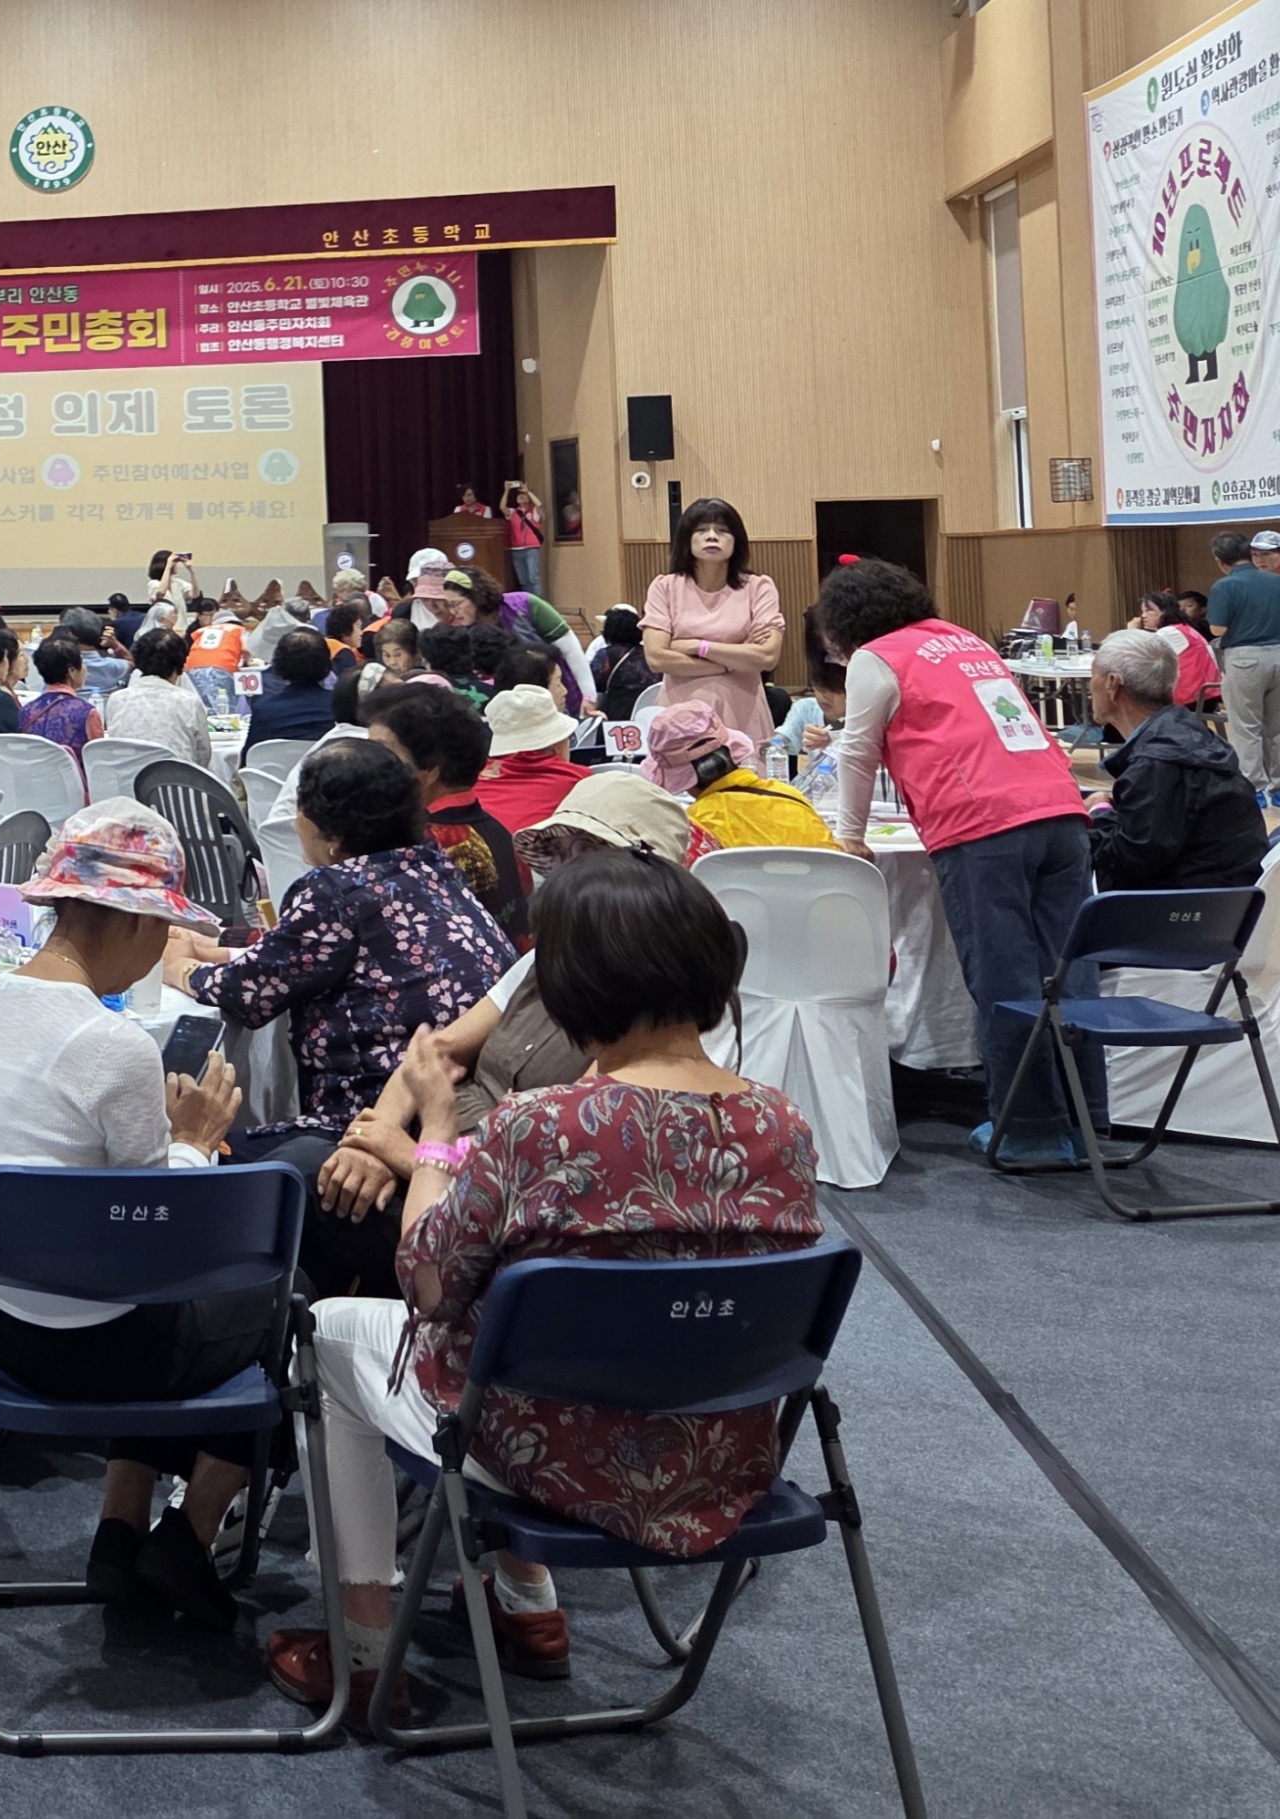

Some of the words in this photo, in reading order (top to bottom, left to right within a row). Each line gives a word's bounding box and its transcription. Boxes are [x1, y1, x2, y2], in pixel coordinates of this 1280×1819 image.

[1161, 55, 1198, 102] 원도심
[1201, 30, 1243, 80] 활성화
[36, 139, 67, 156] 안산
[34, 177, 71, 188] 1899
[29, 284, 79, 304] 안산동
[0, 307, 168, 355] 주민총회
[51, 388, 158, 436] 의제
[183, 384, 294, 432] 토론
[1166, 370, 1251, 458] 주민자치회
[92, 460, 250, 483] 주민참여예산사업
[67, 502, 105, 522] 각각
[958, 660, 1006, 677] 안산동
[238, 674, 259, 692] 10
[608, 725, 642, 752] 13
[109, 1204, 170, 1221] 안산초
[670, 1298, 736, 1319] 안산초
